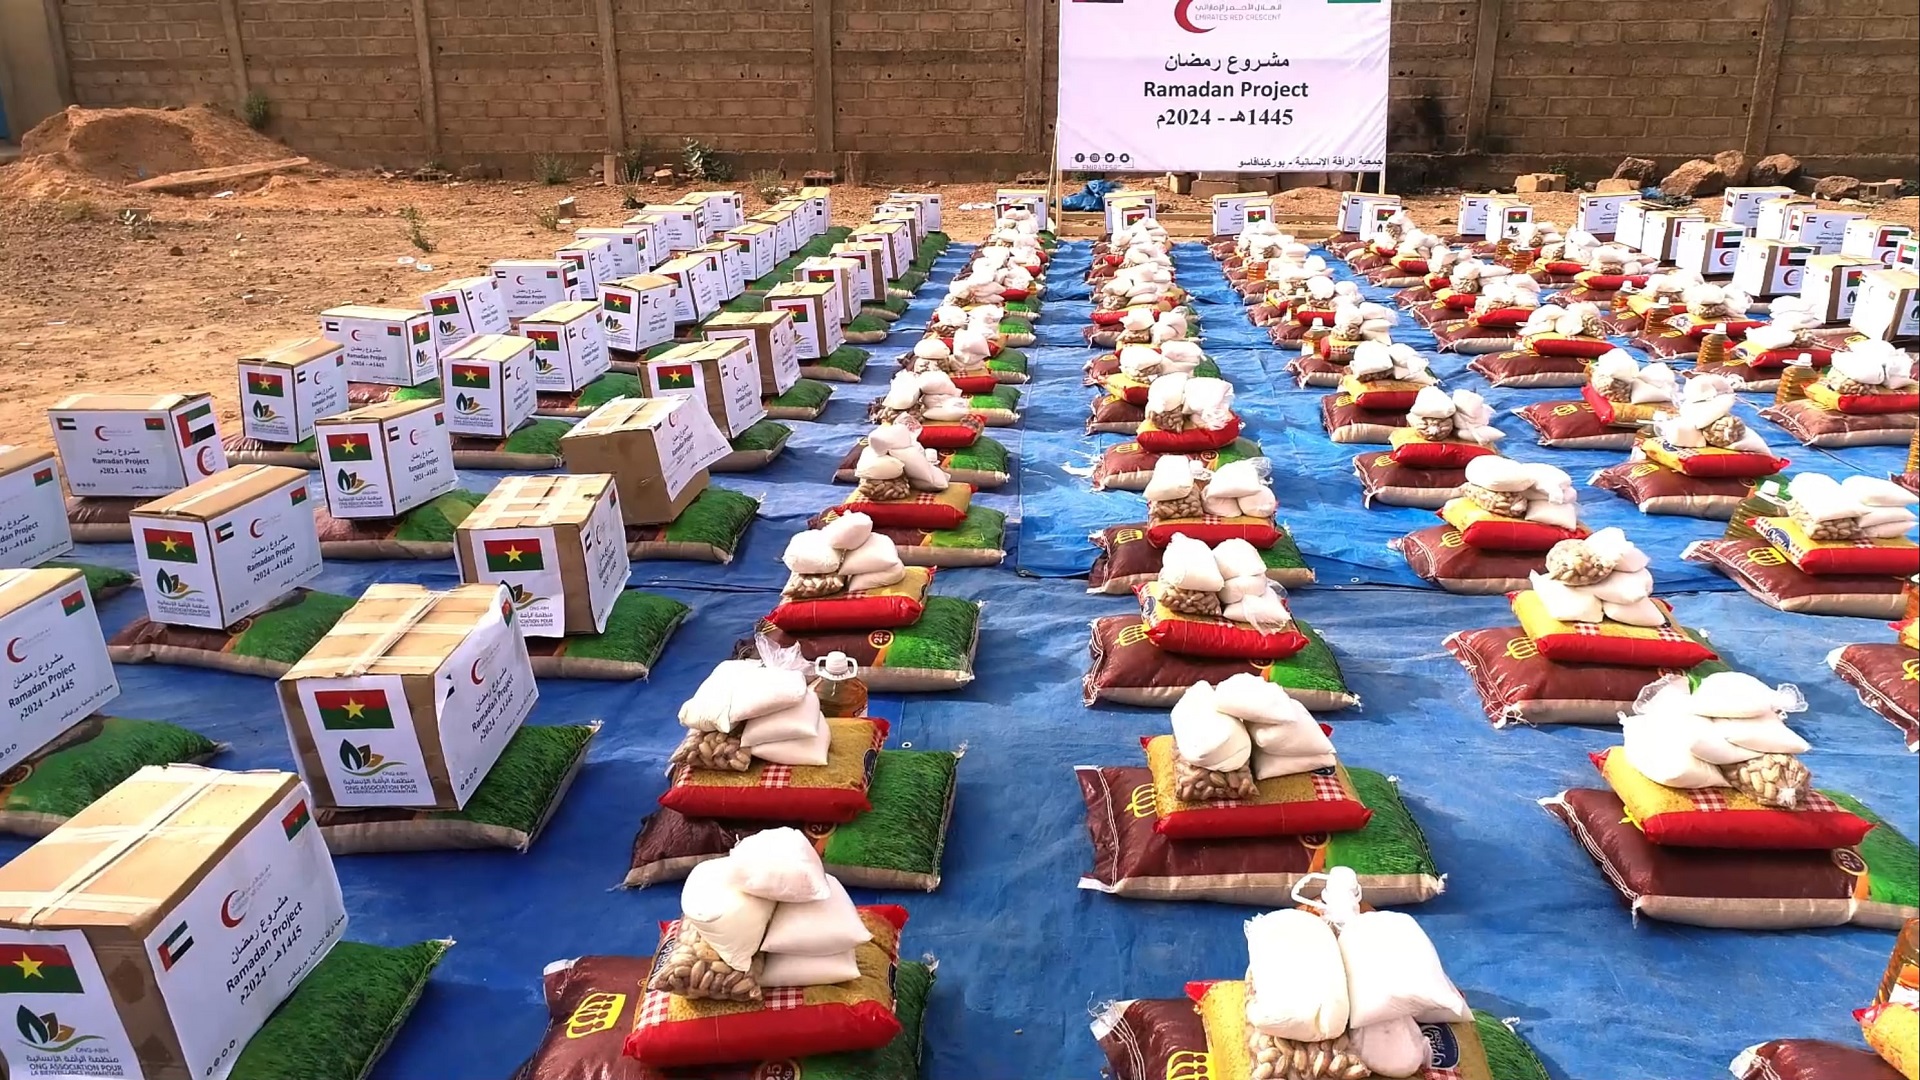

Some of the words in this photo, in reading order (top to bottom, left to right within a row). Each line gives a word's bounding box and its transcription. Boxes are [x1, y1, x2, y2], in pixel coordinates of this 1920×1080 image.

[1165, 53, 1221, 71] رمضان
[1227, 53, 1289, 74] مشروع
[1144, 81, 1234, 97] Ramadan
[1241, 81, 1308, 101] Project
[1358, 157, 1383, 166] جمعية
[125, 458, 149, 466] Project
[14, 521, 39, 536] Project
[247, 553, 275, 573] Ramadan
[276, 542, 296, 561] Project
[873, 632, 883, 644] 25
[38, 653, 64, 676] مشروع
[8, 680, 48, 709] Ramadan
[48, 662, 76, 685] Project
[13, 670, 38, 690] رمضان
[471, 697, 498, 733] Ramadan
[497, 674, 515, 702] Project
[259, 895, 289, 934] مشروع
[226, 938, 273, 993] Ramadan
[271, 901, 303, 942] Project
[231, 928, 260, 965] رمضان
[50, 1063, 99, 1071] ASSOCIATION
[101, 1064, 122, 1072] POUR
[88, 1055, 119, 1063] منظمة
